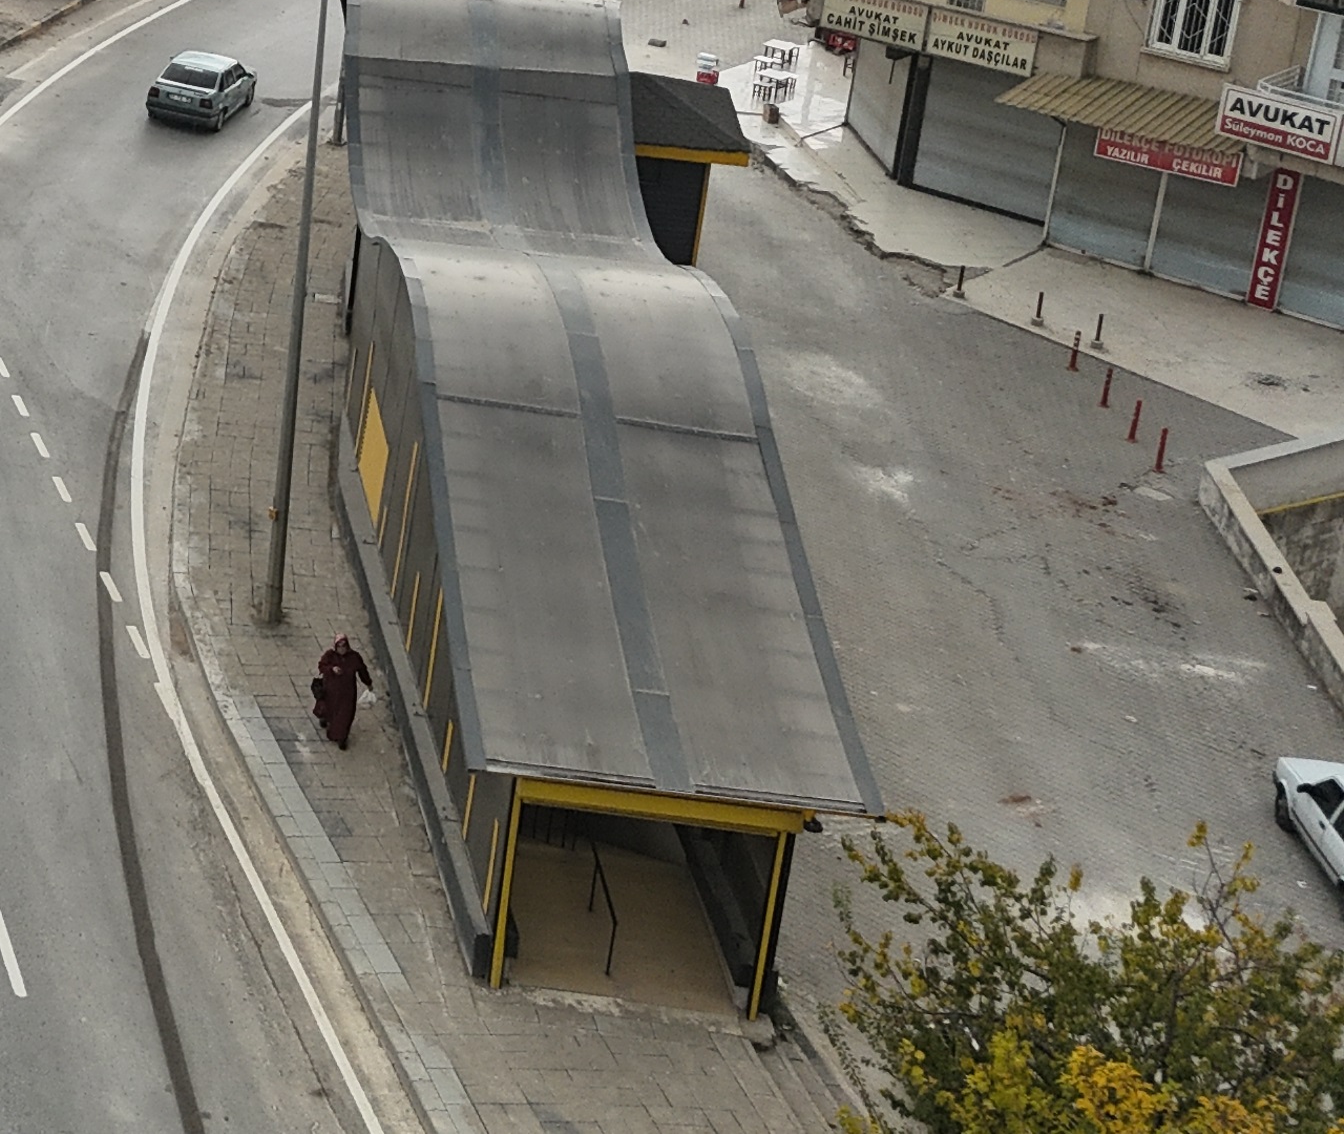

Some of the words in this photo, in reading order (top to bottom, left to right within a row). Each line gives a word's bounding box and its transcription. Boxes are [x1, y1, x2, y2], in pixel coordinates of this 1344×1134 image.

[849, 6, 899, 24] AVUKAT
[827, 13, 865, 32] CAHİT
[868, 21, 917, 44] ŞİMŞEK
[957, 31, 1010, 51] AVUKAT
[932, 38, 969, 56] AYKUT
[972, 47, 1028, 70] DAŞÇILAR
[1229, 97, 1331, 136] AVUKAT
[1107, 146, 1150, 164] YAZILIR
[1286, 134, 1326, 155] KOCA
[1254, 174, 1294, 300] DİLEKÇE
